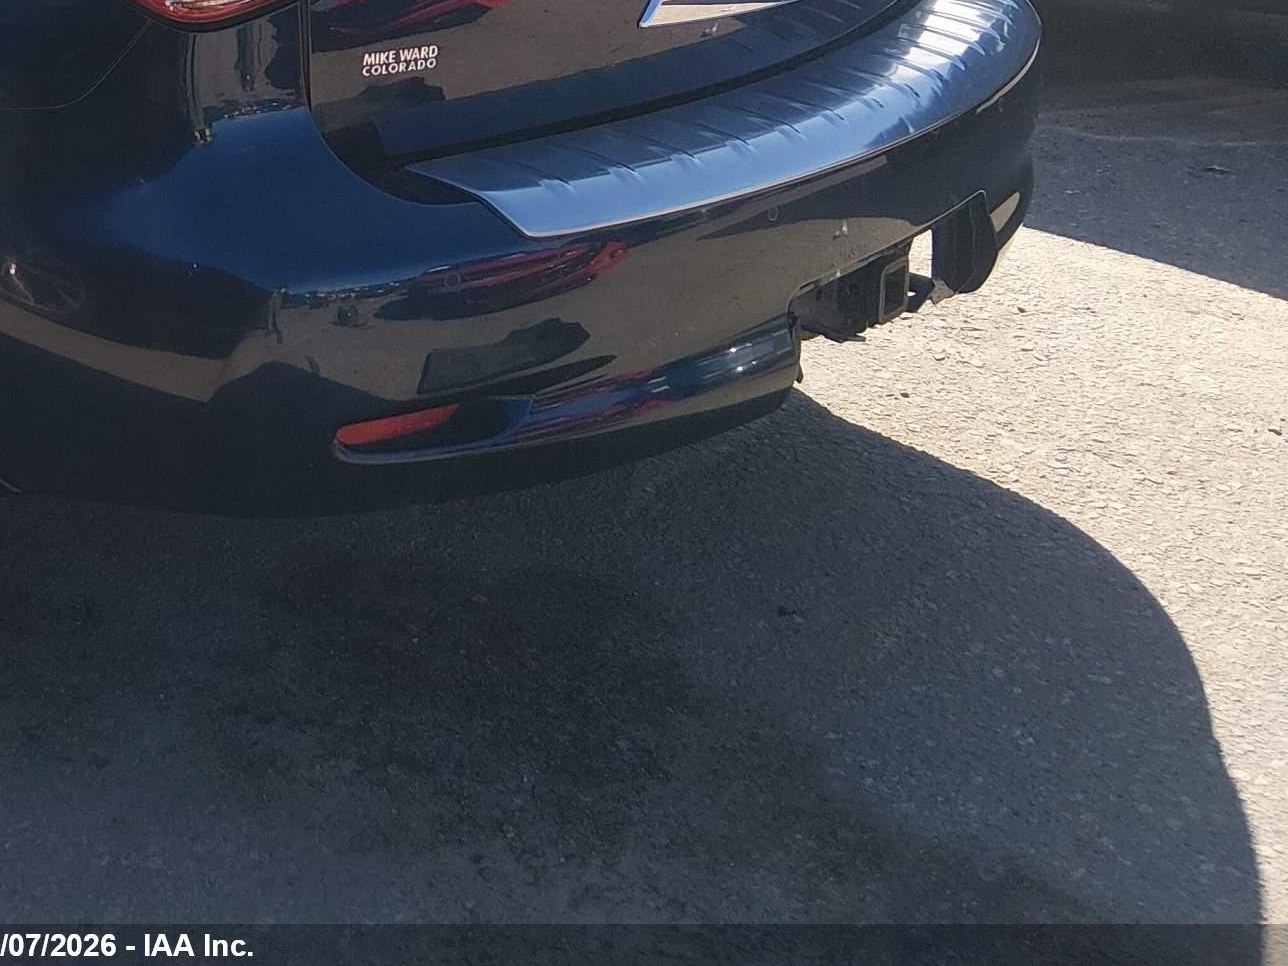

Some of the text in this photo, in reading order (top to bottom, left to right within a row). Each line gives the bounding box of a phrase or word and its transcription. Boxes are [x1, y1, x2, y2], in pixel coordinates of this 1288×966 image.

[362, 45, 439, 66] MIKE WARD
[362, 58, 437, 77] COLORADO
